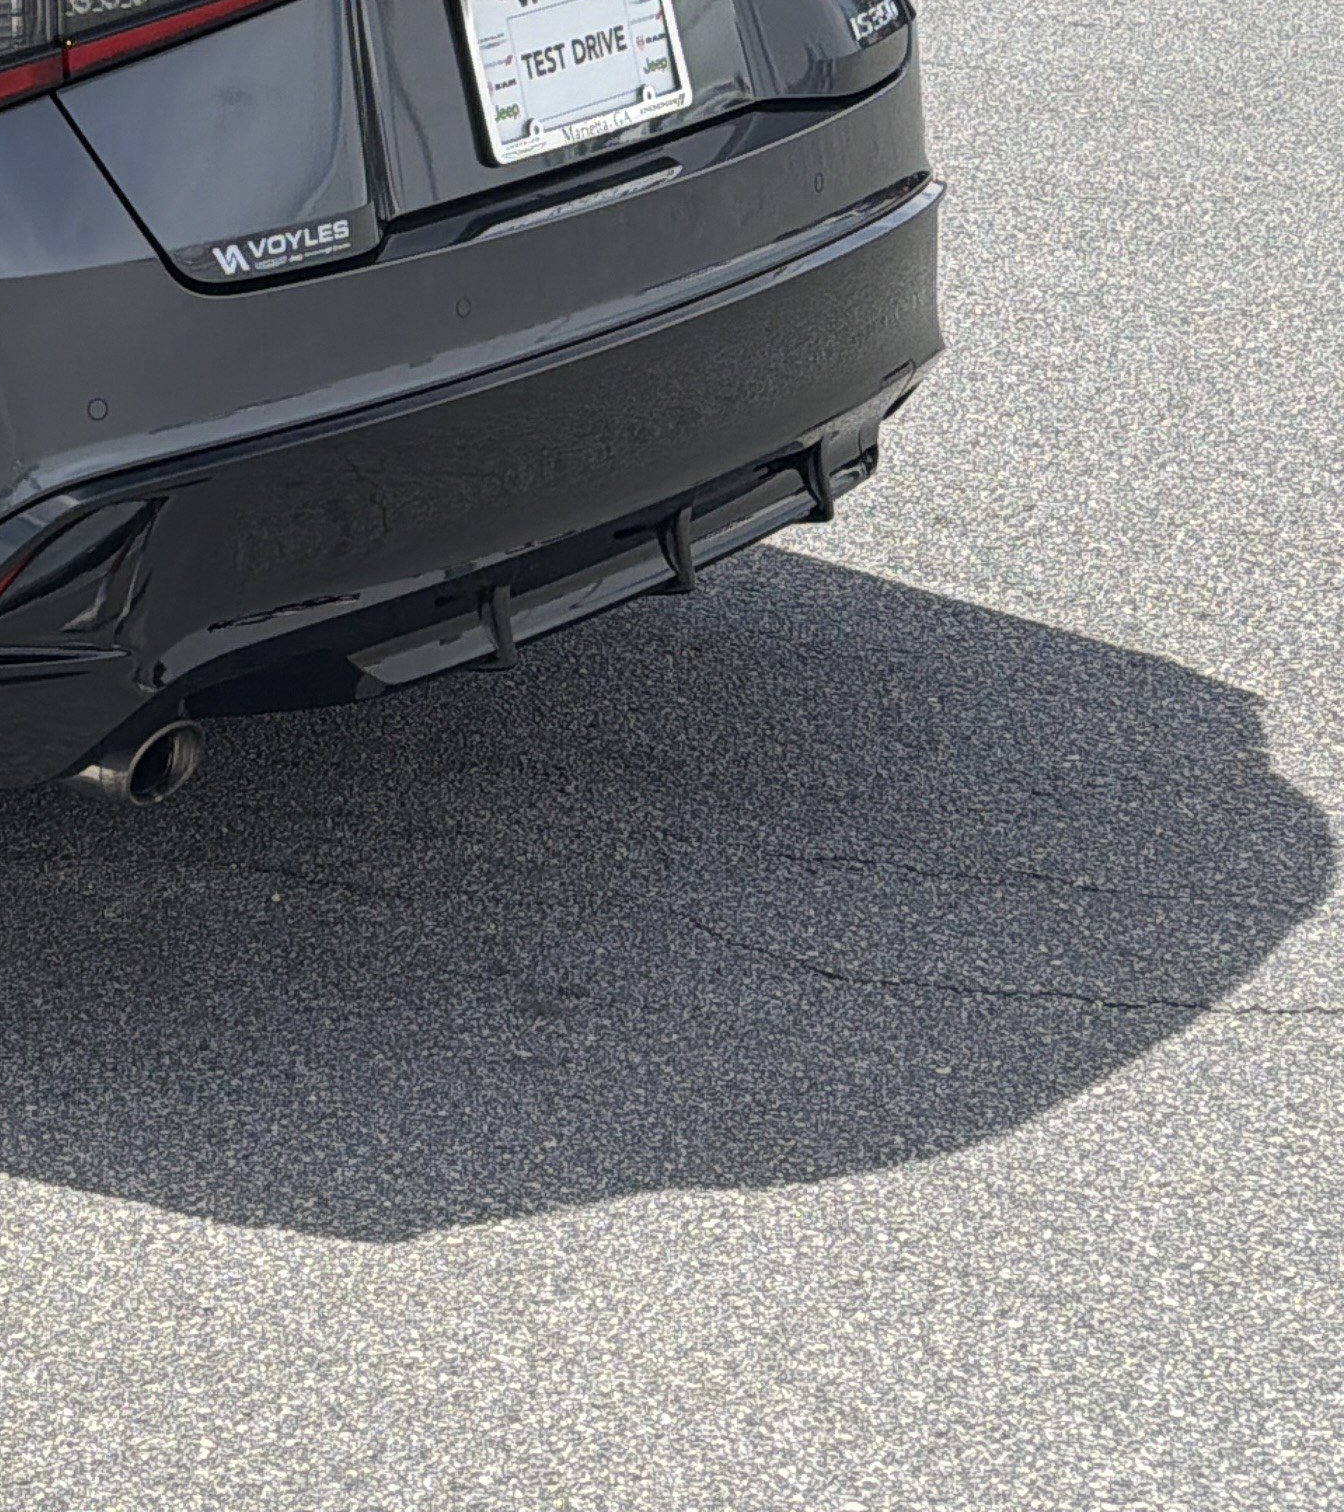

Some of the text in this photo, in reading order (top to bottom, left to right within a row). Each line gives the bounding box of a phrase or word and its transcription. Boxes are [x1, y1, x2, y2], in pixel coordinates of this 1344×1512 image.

[521, 25, 628, 80] TEST DRIVE
[643, 57, 668, 75] Jeep
[494, 103, 520, 123] Jeep
[248, 219, 349, 258] VOYLES
